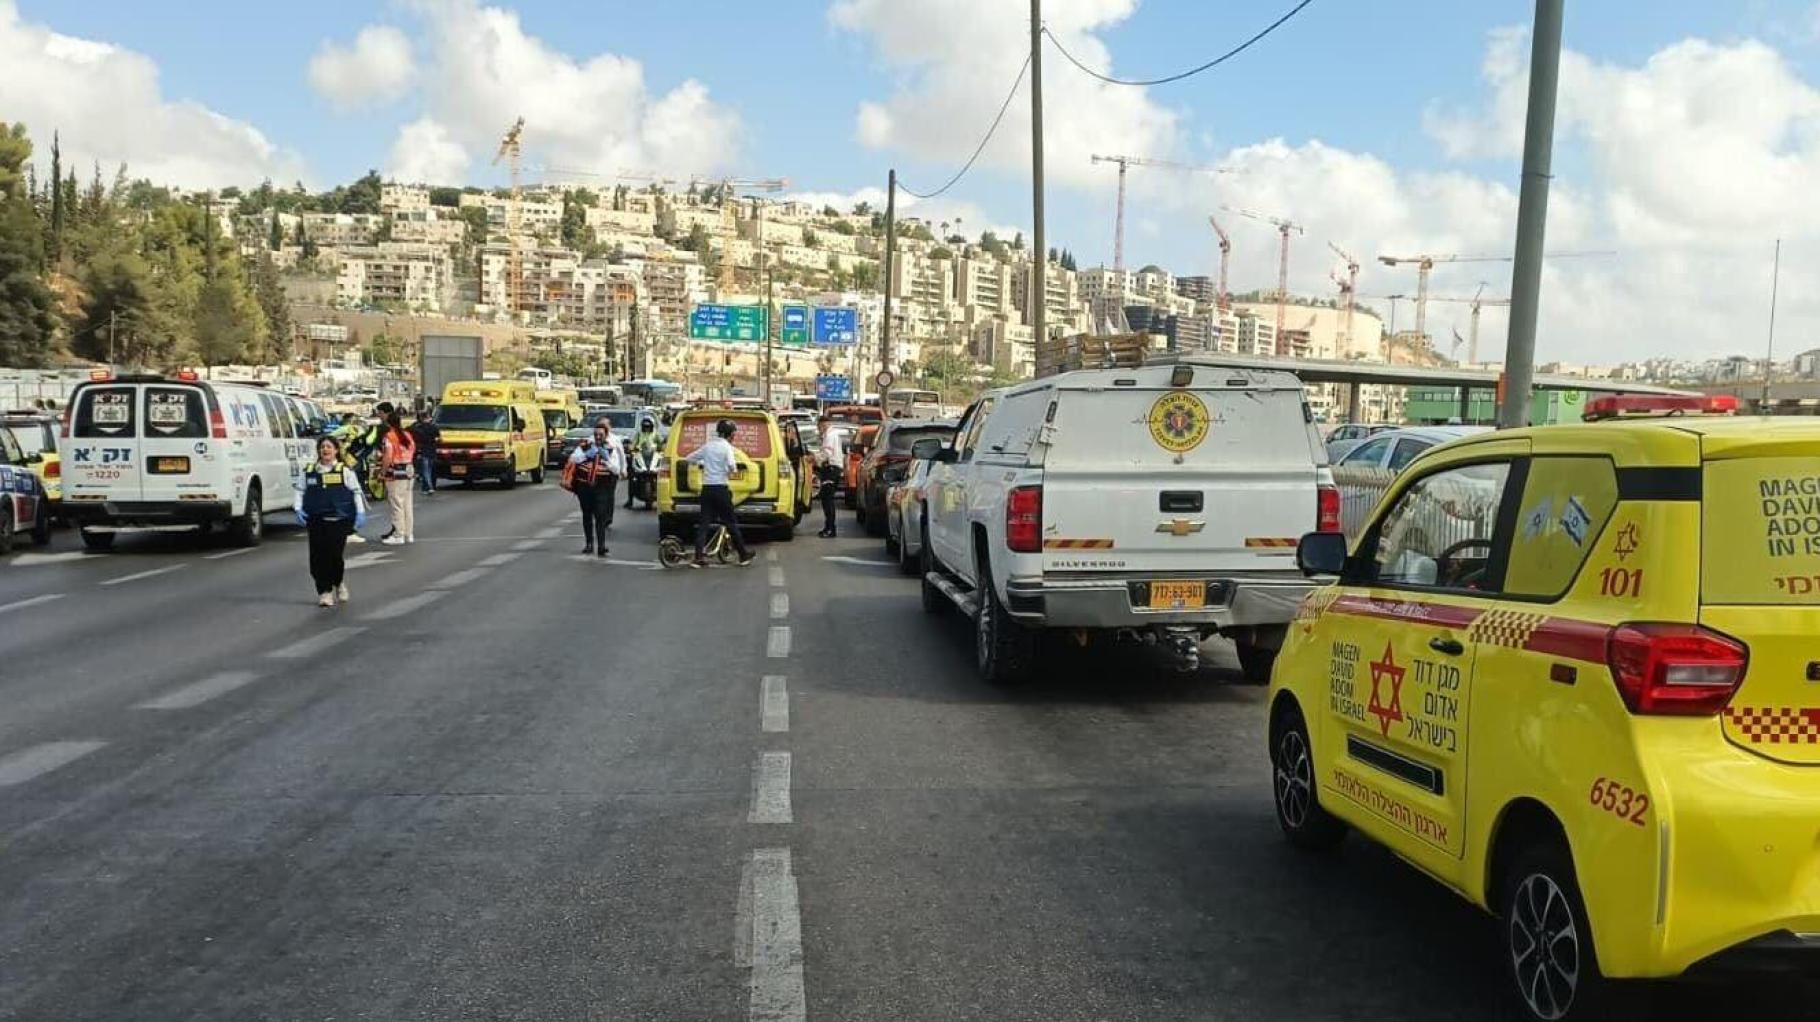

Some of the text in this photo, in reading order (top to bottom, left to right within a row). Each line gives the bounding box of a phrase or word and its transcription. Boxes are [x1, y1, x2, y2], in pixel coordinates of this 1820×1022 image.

[1759, 477, 1820, 498] MAG
[1768, 538, 1795, 557] IN
[1600, 568, 1643, 597] 101
[1332, 640, 1360, 662] MAGEN
[1330, 659, 1355, 680] DAVID
[1413, 659, 1460, 691] מגן דוד
[1330, 678, 1354, 698] ADOM
[1340, 698, 1366, 721] ISRAEL
[1424, 692, 1459, 722] אדום
[1406, 712, 1457, 752] בישראל
[1334, 768, 1448, 845] ארגון ההצלה הלאומי
[1590, 777, 1649, 828] 6532
